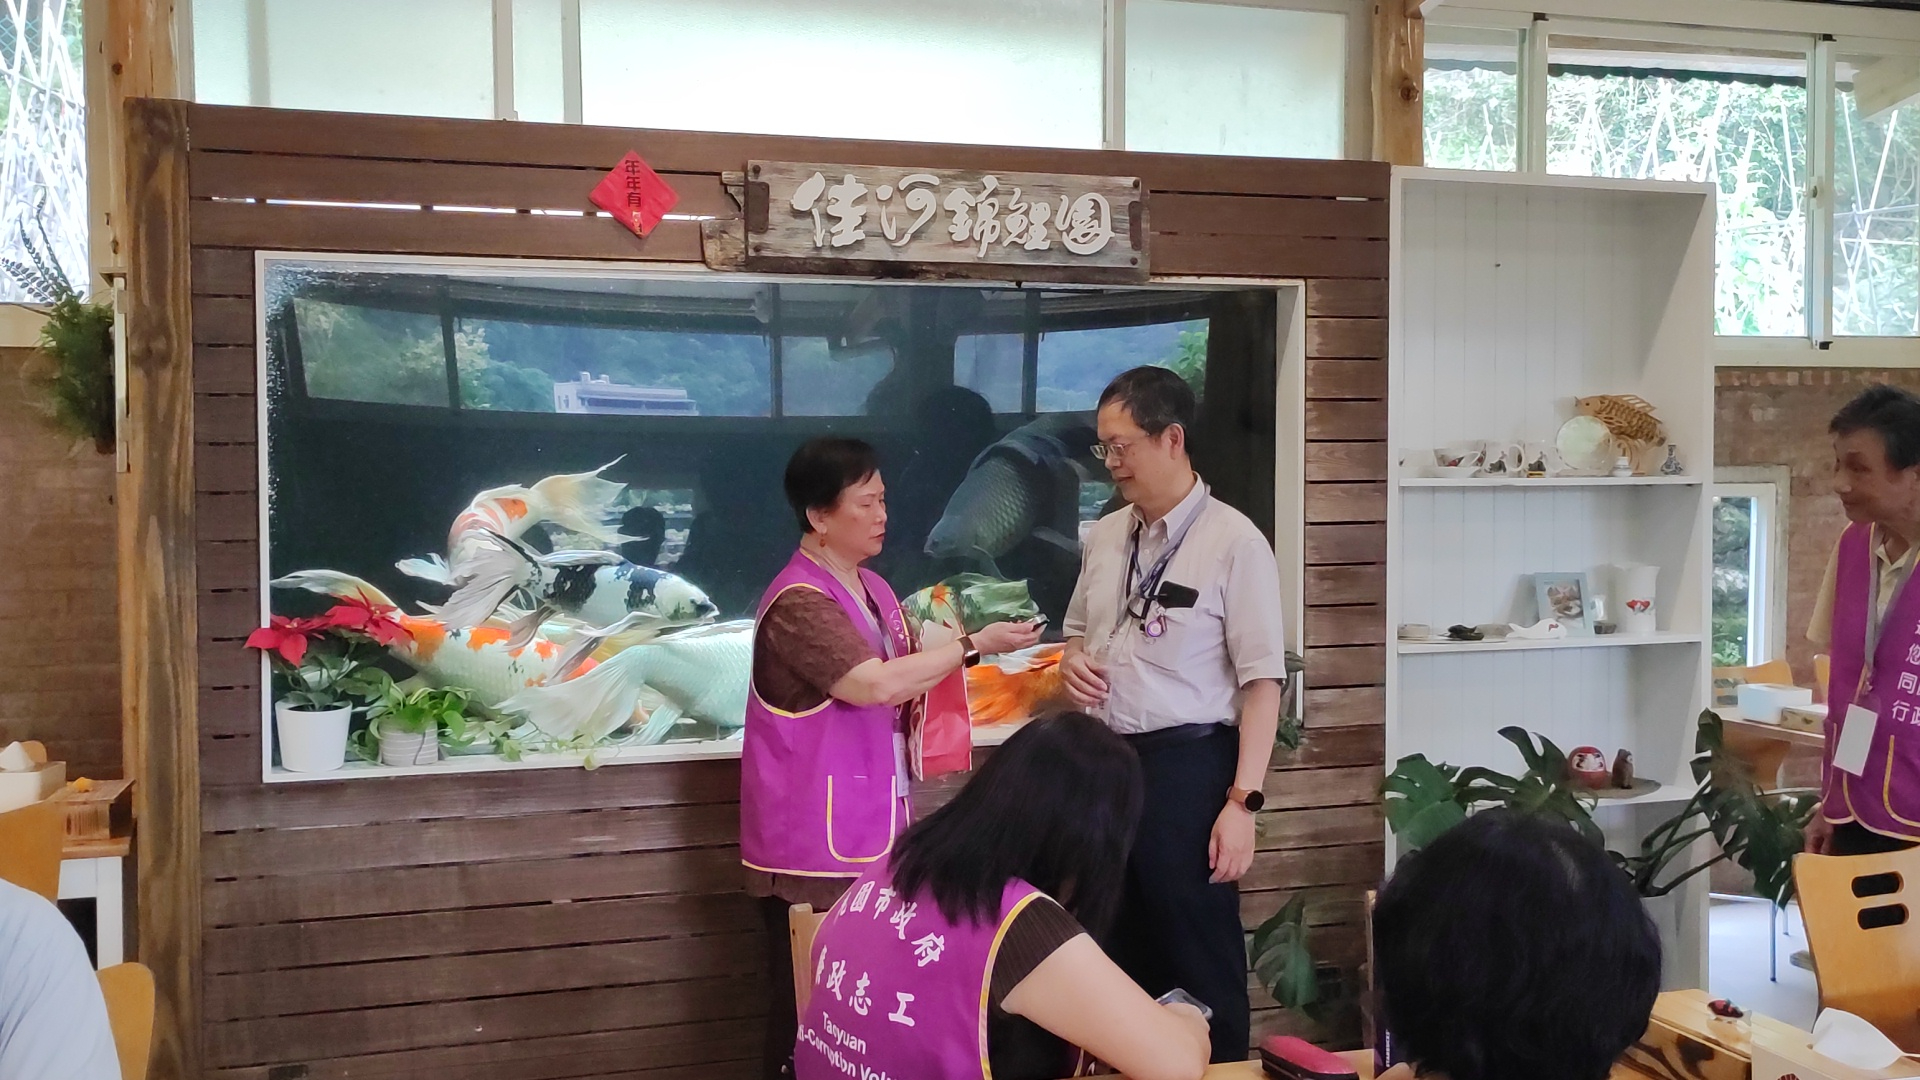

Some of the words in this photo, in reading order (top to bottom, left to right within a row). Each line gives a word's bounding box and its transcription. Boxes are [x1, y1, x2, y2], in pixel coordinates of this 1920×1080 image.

[790, 171, 1115, 258] 佳河錦鯉園
[1892, 619, 1920, 722] 您同行
[797, 1024, 857, 1078] ti-Corruption
[823, 1011, 867, 1055] Taoyuan
